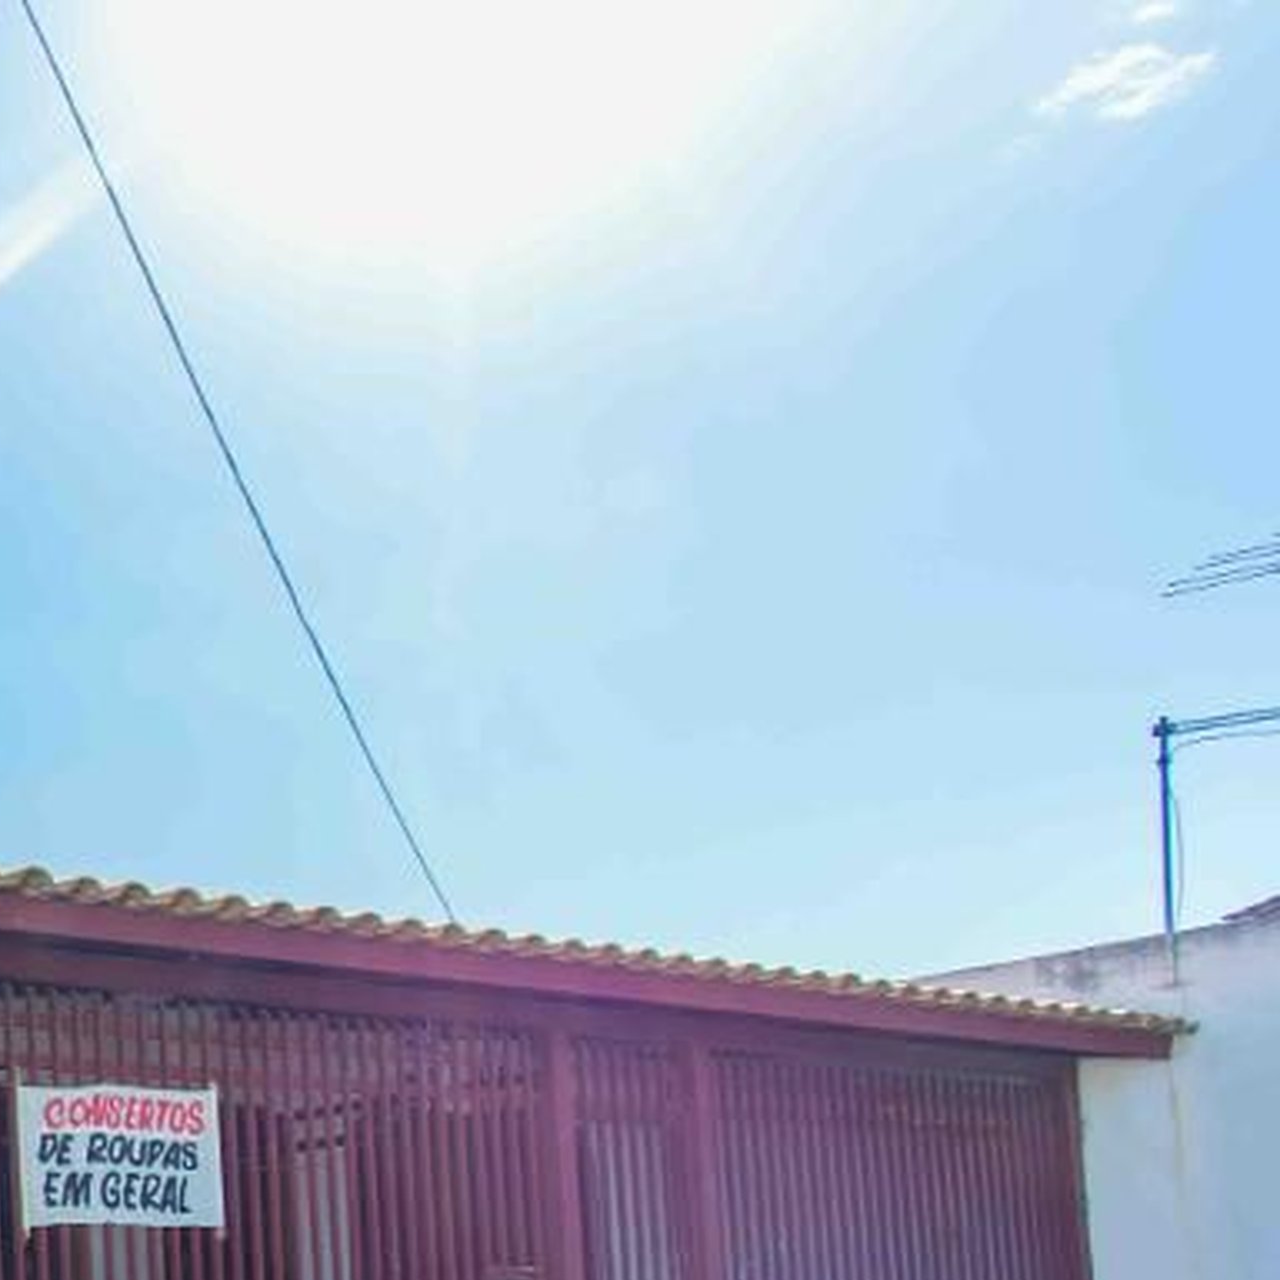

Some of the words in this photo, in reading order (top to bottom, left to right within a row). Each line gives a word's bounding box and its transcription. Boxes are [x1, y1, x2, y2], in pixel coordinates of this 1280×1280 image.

[43, 1094, 206, 1134] CONSERTOS
[37, 1133, 74, 1165] DE
[86, 1133, 198, 1170] ROUPAS
[43, 1172, 93, 1207] EM
[99, 1172, 193, 1213] GERAL
